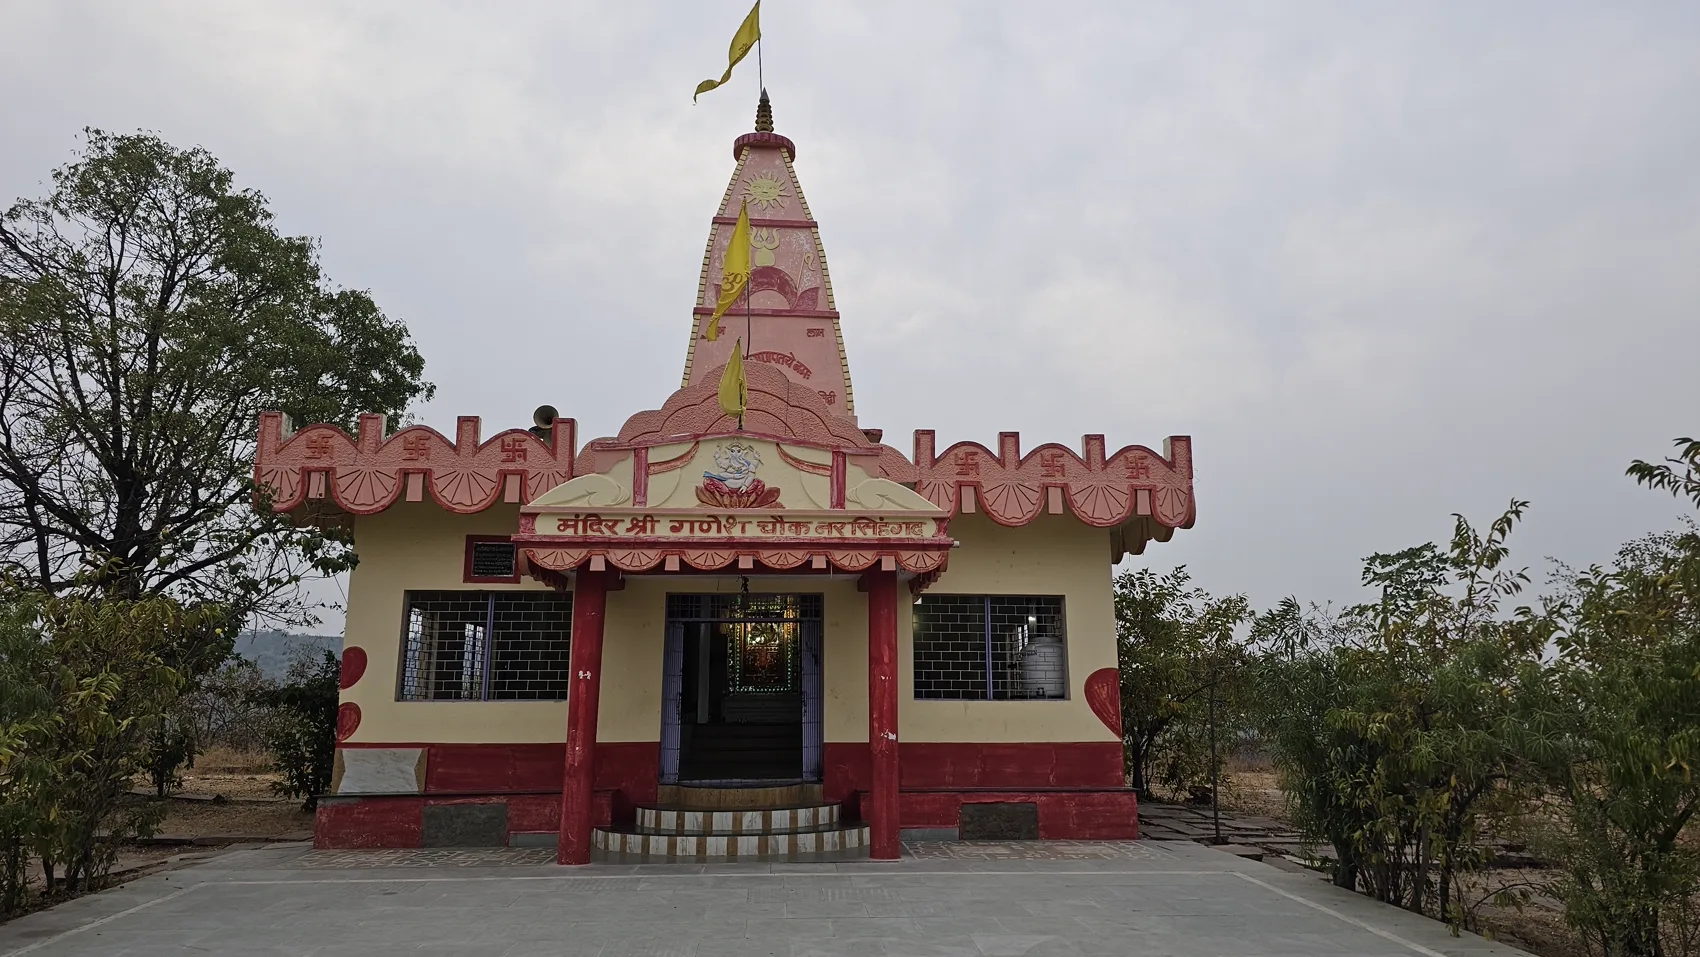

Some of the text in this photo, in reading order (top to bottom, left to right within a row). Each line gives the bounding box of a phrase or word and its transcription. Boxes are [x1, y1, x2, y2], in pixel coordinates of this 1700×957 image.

[557, 513, 626, 535] मंदिर
[625, 514, 661, 535] श्री
[669, 514, 753, 535] गणेश
[756, 515, 813, 536] चौक
